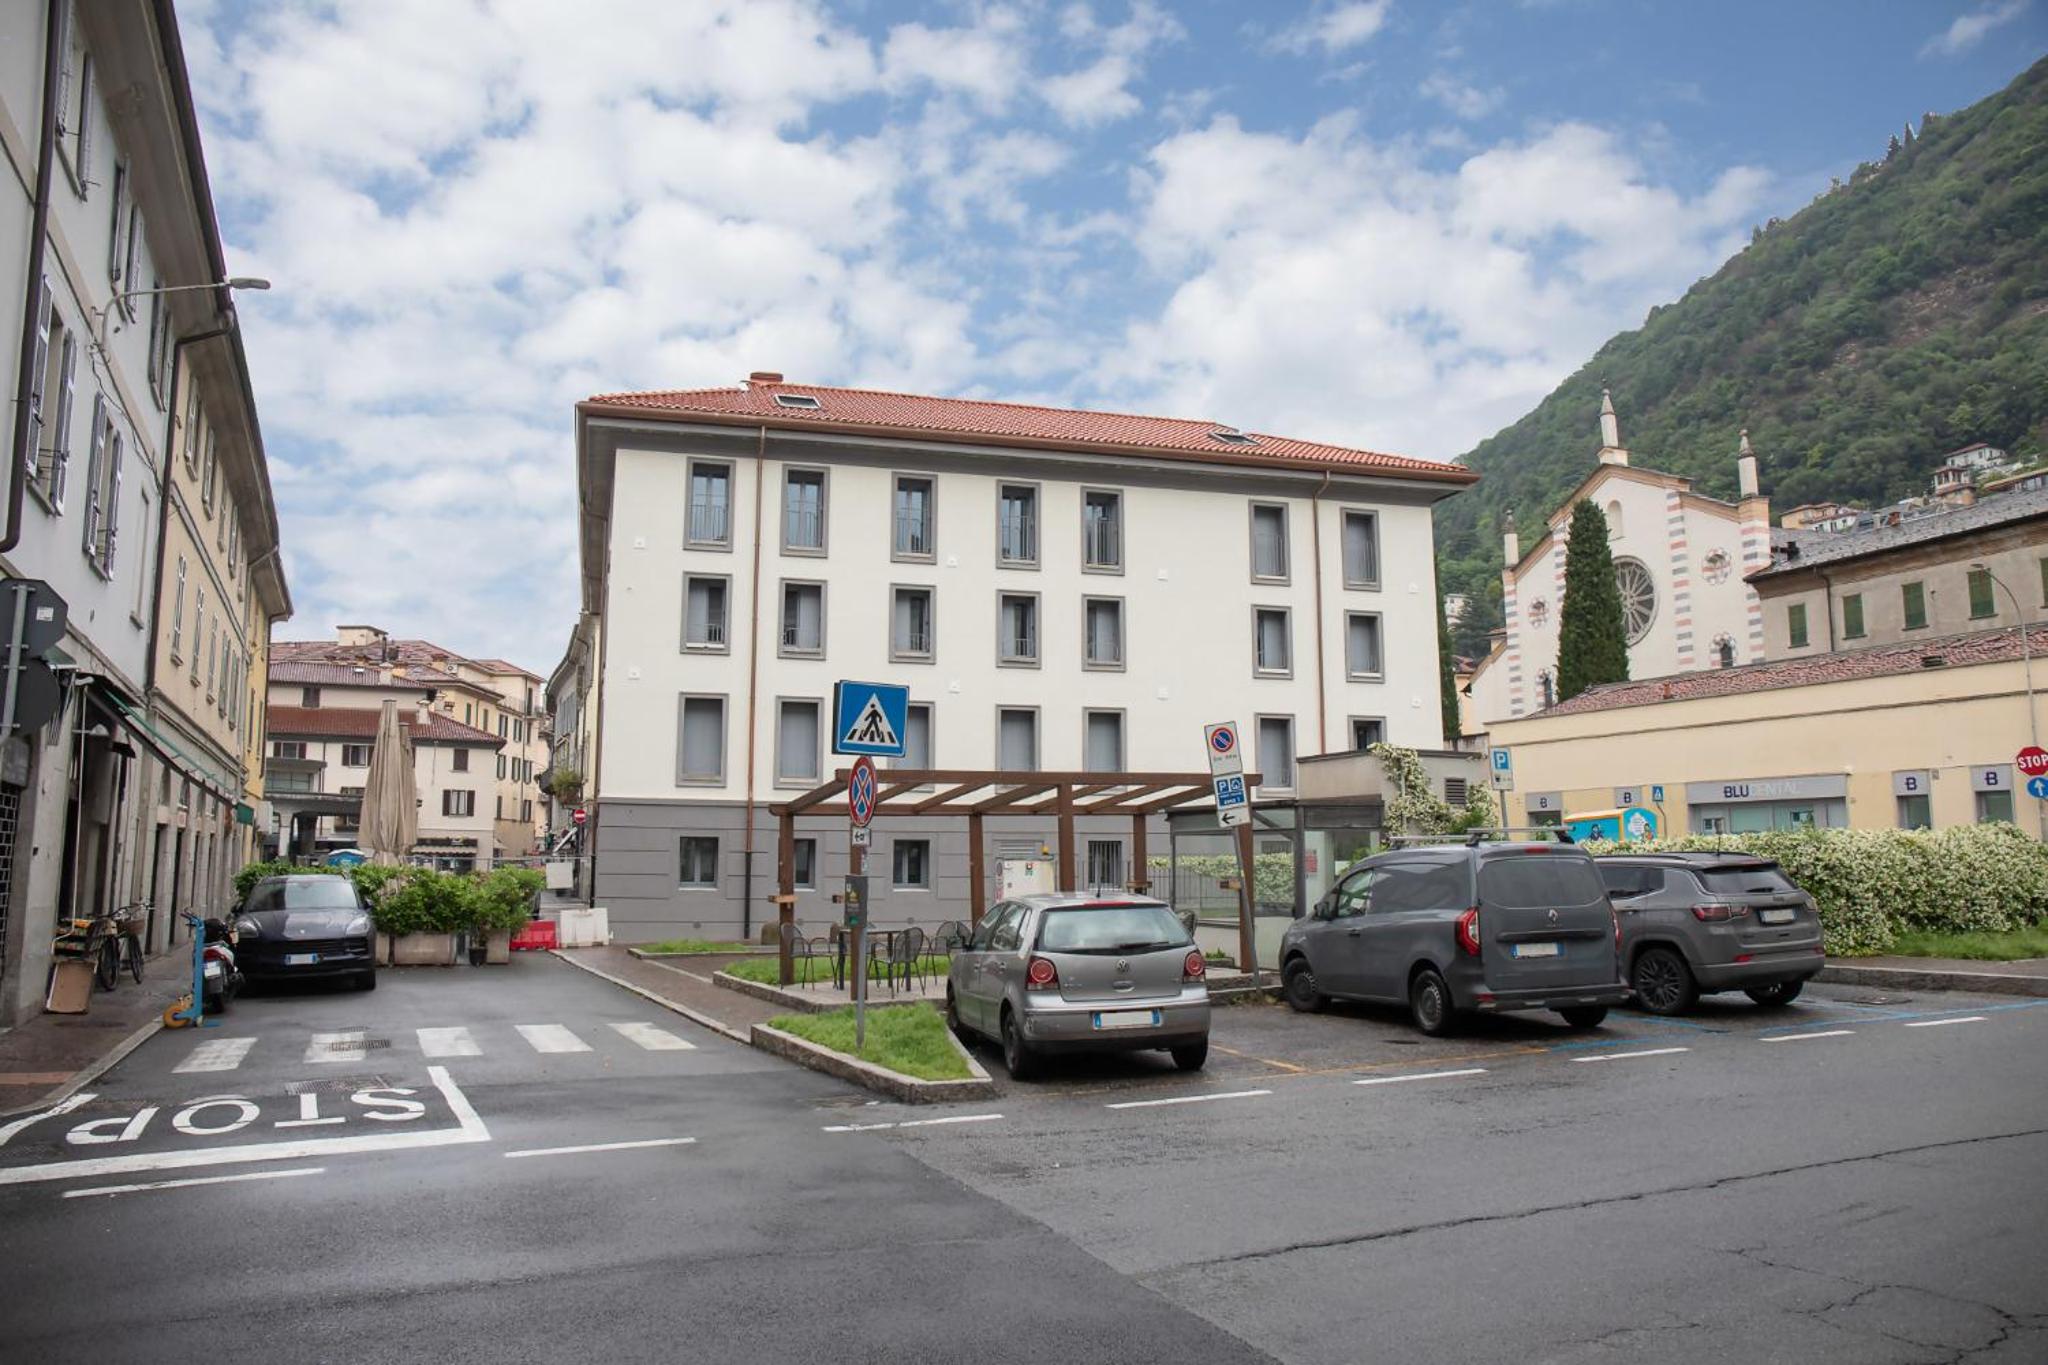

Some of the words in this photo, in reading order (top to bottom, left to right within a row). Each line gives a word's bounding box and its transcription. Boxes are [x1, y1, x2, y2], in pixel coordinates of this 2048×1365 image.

[1496, 753, 1506, 768] P
[2018, 754, 2048, 769] STOP
[65, 1088, 425, 1145] STOP
